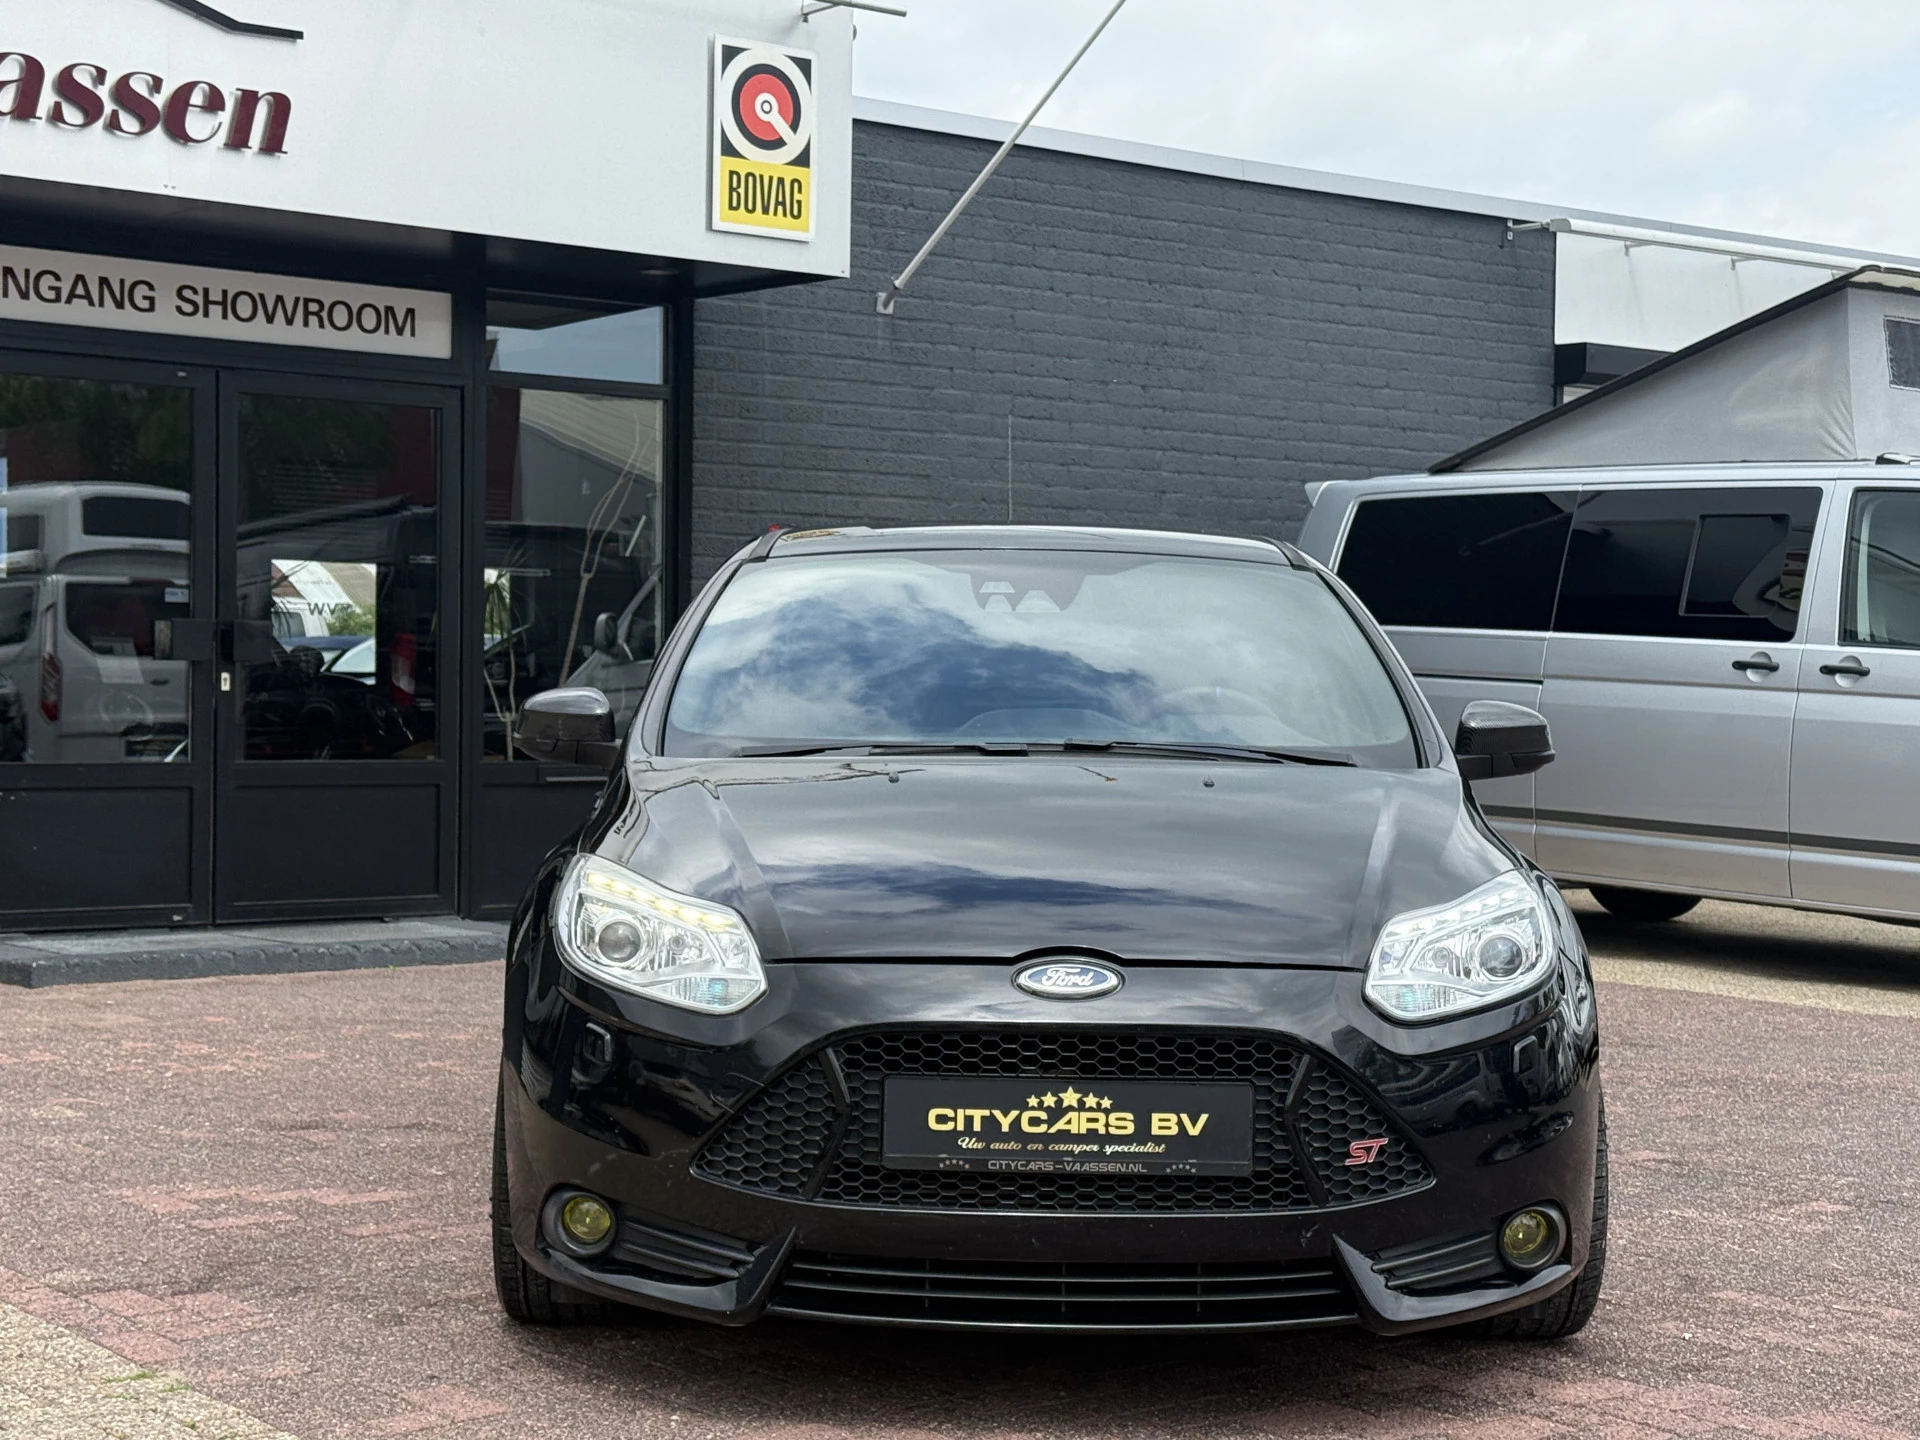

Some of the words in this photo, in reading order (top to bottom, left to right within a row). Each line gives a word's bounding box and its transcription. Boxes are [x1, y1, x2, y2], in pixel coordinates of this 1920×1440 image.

[0, 51, 292, 154] assen
[728, 169, 803, 220] BOVAG
[2, 265, 157, 313] NGANG
[174, 283, 417, 338] SHOWROOM
[1041, 967, 1095, 987] Ford
[927, 1107, 1136, 1136] CITYCARS
[1150, 1112, 1210, 1137] BV
[957, 1136, 987, 1150] Uw
[989, 1140, 1022, 1151] auto
[1026, 1143, 1045, 1151] en
[1048, 1142, 1100, 1155] camper
[1102, 1141, 1167, 1156] specialist
[1344, 1137, 1389, 1166] ST
[987, 1159, 1148, 1173] CITYCARS-VAASSEN.NL
